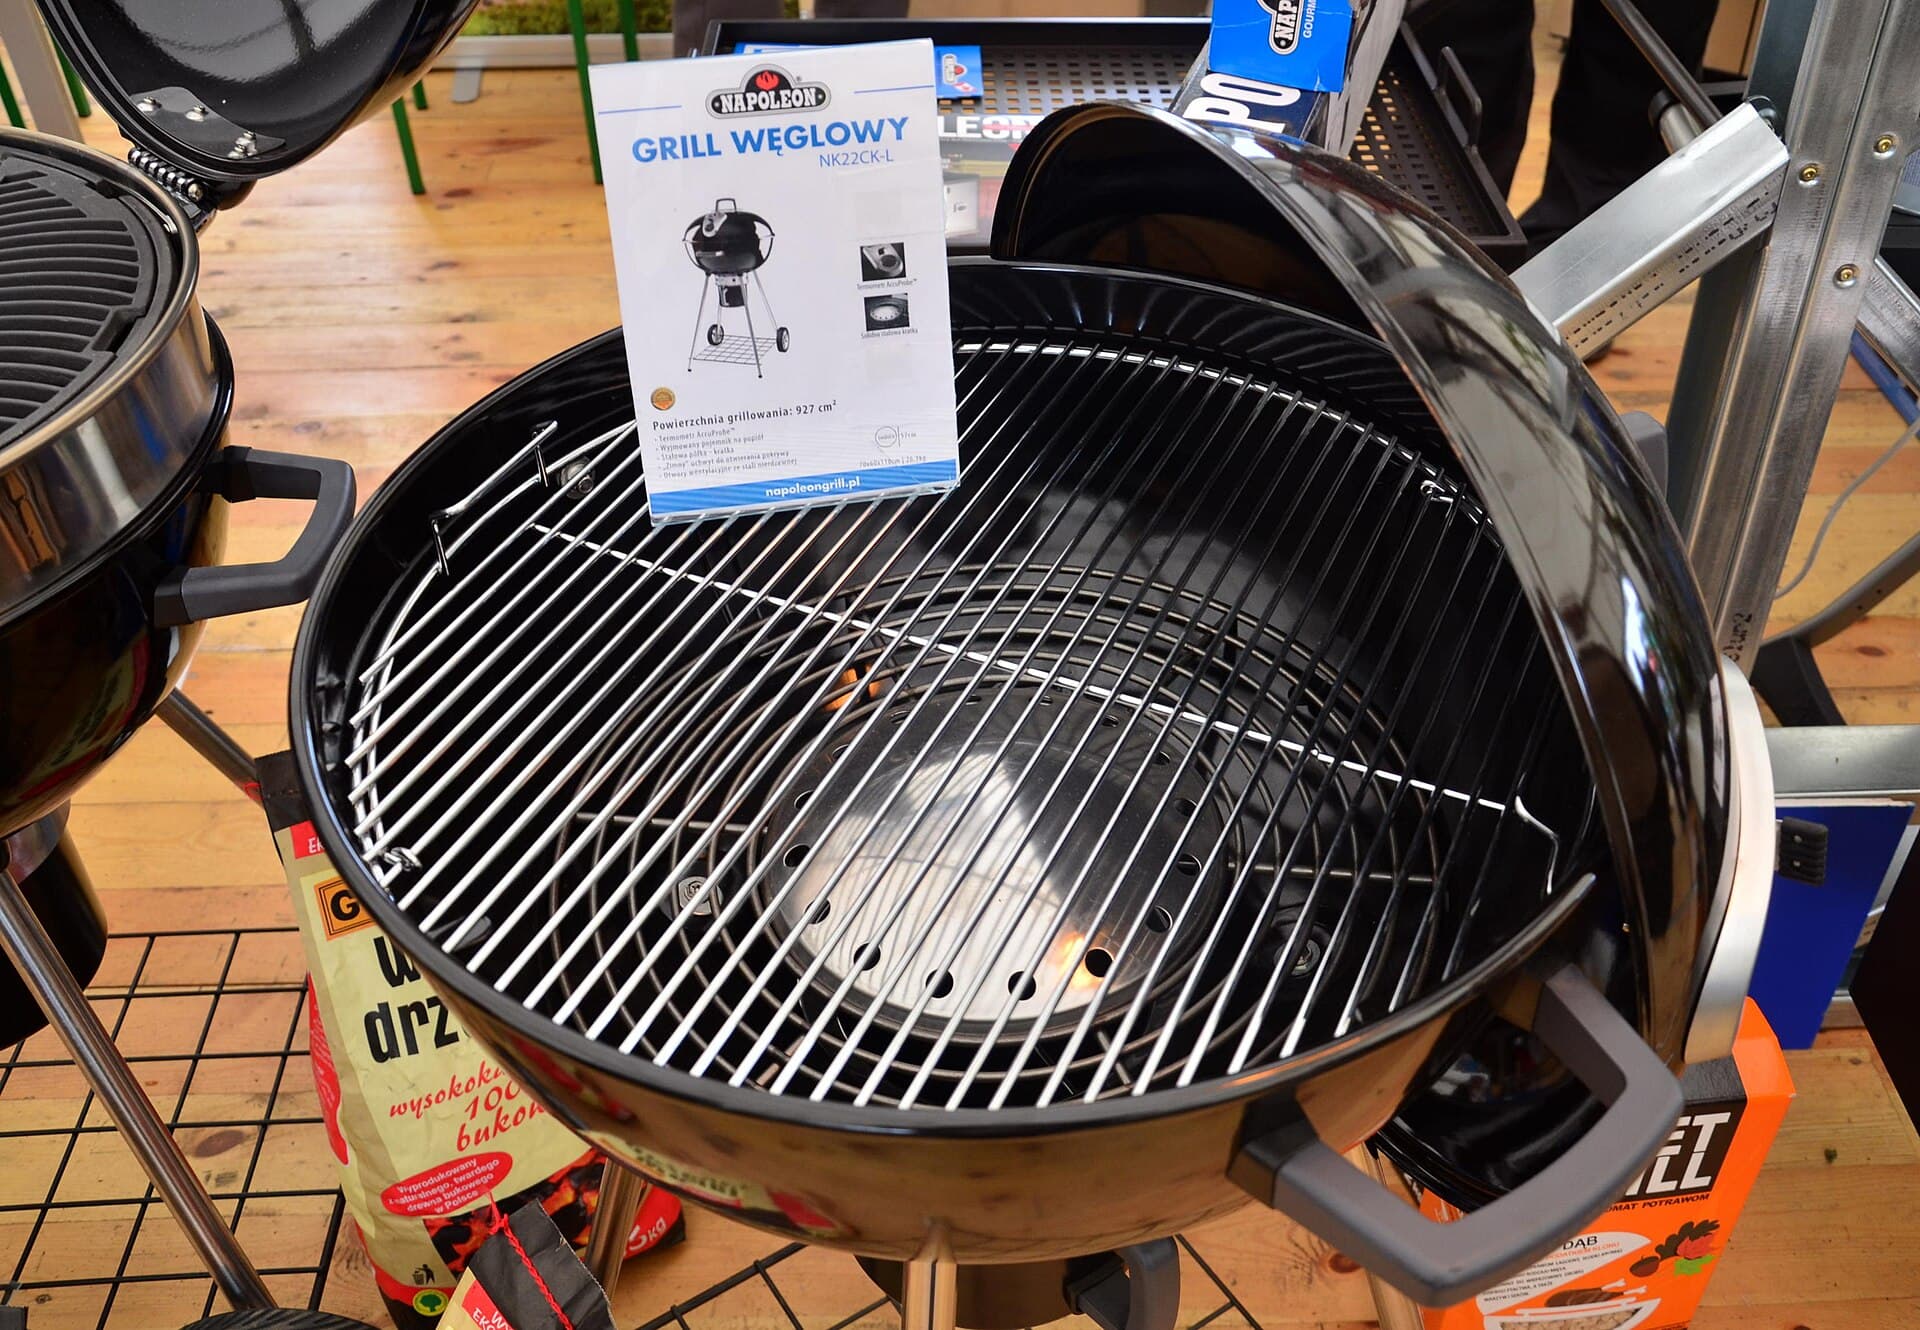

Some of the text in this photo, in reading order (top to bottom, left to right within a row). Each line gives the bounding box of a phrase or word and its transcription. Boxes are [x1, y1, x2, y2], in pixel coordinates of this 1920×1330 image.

[720, 87, 817, 114] NAPOLEON
[632, 117, 909, 163] GRILL WĘGLOWY
[819, 149, 894, 168] NK22CK-L
[652, 414, 724, 431] Powierzchnia
[727, 407, 793, 425] grillowania:
[796, 404, 815, 415] 927
[765, 476, 861, 497] napoleongrill.pl
[363, 995, 471, 1064] drz
[397, 1157, 477, 1194] Wyprodukowany
[453, 1158, 500, 1184] twardego
[407, 1172, 494, 1213] drewna bukowego
[444, 1190, 479, 1210] Polsce
[1641, 1193, 1711, 1209] POTRAWOM
[1562, 1235, 1598, 1251] DĄB
